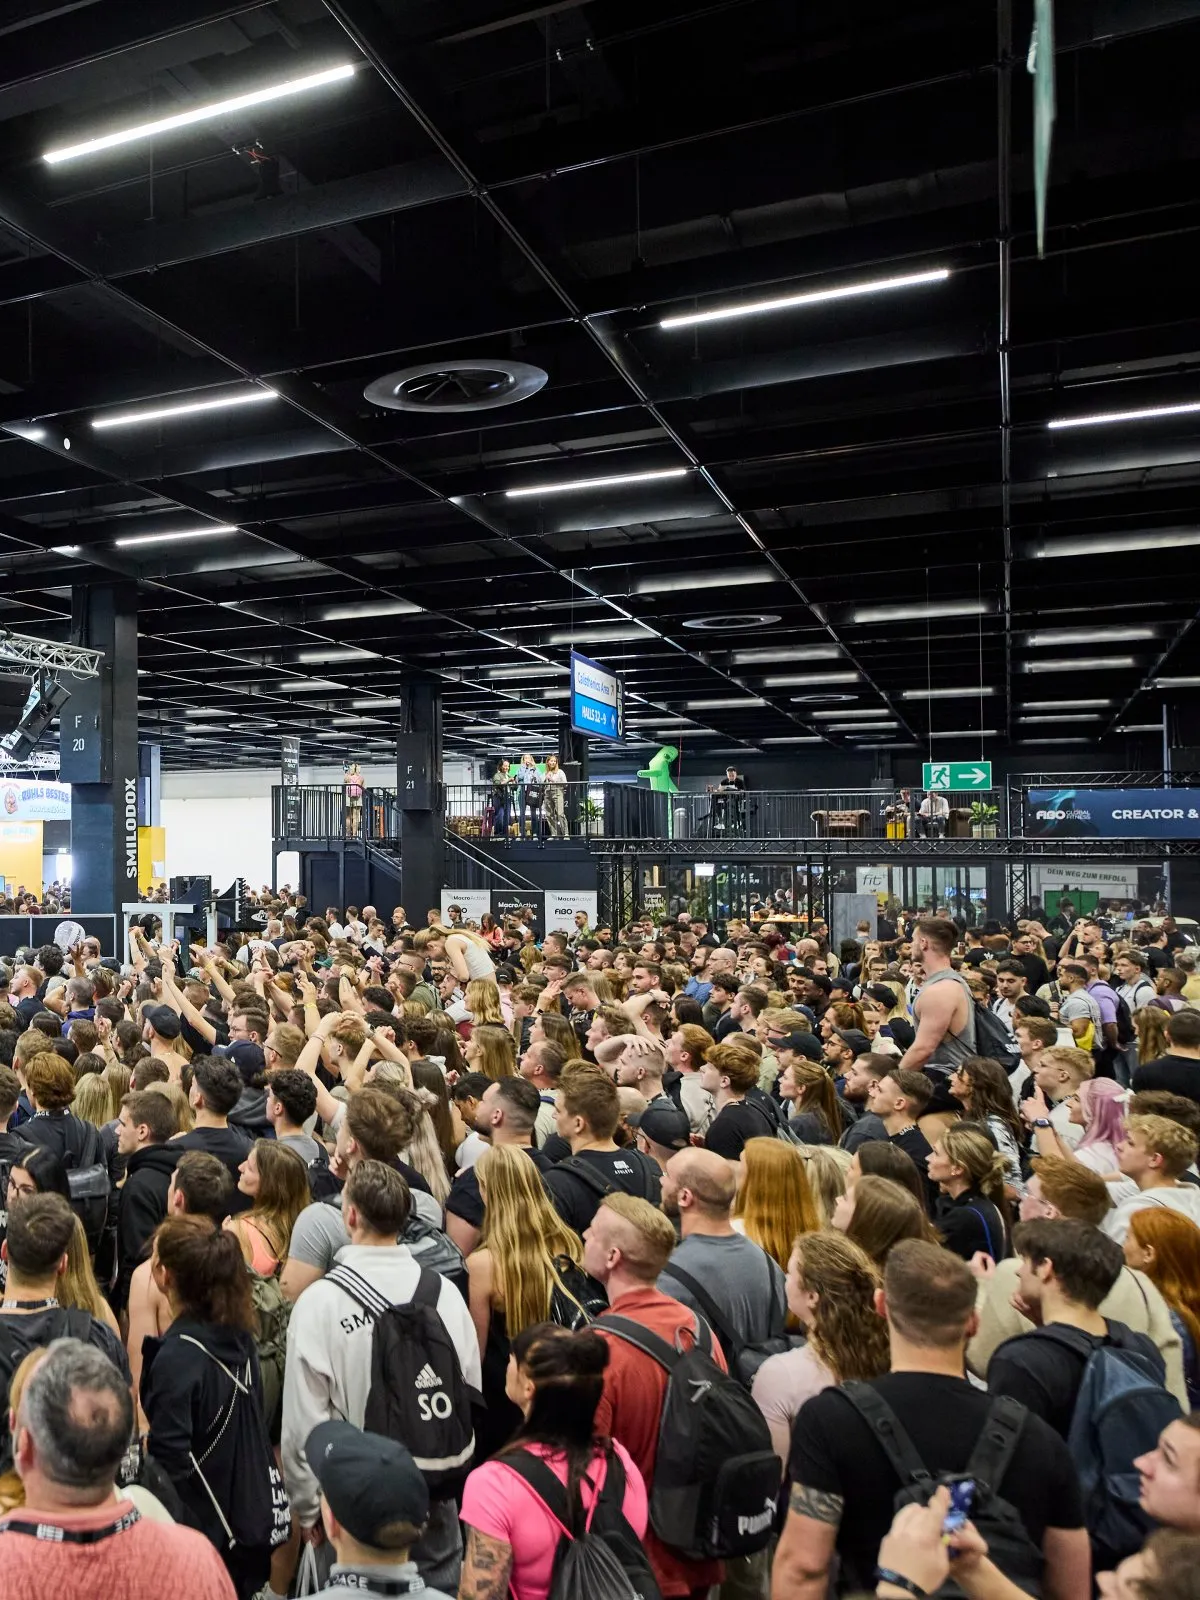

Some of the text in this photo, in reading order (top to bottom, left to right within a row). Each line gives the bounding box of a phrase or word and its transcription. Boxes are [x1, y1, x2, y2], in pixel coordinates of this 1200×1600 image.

[75, 715, 82, 728] F
[72, 738, 85, 751] 20
[407, 765, 413, 775] F
[406, 780, 415, 790] 21
[1036, 810, 1066, 820] FIBO
[1112, 809, 1199, 820] CREATOR &
[124, 777, 137, 880] SMILODOX
[1047, 867, 1064, 876] DEIN
[1081, 871, 1098, 879] ZUM
[1099, 873, 1127, 882] ERFOLG
[498, 901, 538, 909] MacroActive
[414, 1376, 443, 1389] adidas
[417, 1391, 453, 1421] SO
